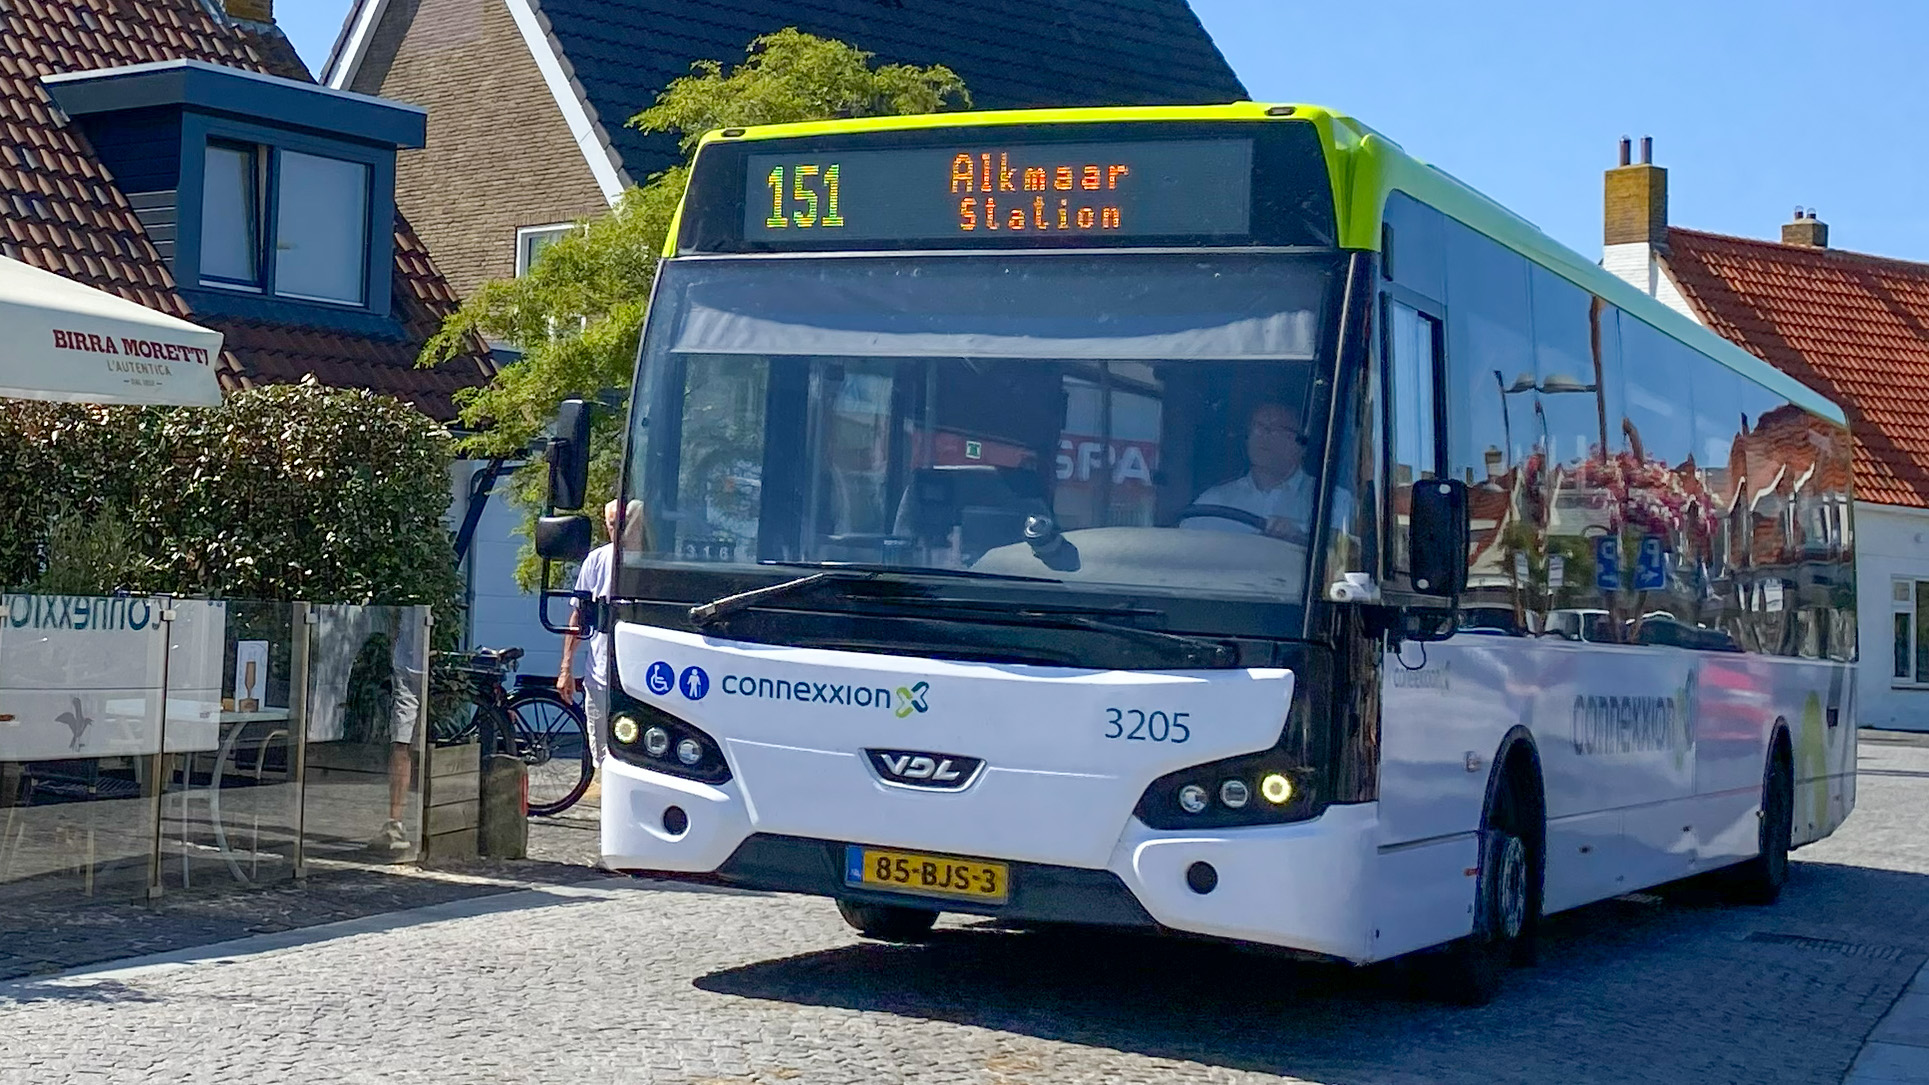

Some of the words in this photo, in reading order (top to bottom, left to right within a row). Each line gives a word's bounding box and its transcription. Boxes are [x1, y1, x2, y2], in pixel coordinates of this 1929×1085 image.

[951, 152, 1129, 194] Alkmaar
[766, 163, 845, 229] 151
[958, 195, 1123, 231] Station
[53, 329, 119, 355] BIRRA
[107, 359, 172, 376] L'AUTENTICA
[722, 674, 891, 709] connexxion
[1105, 707, 1190, 744] 3205
[880, 753, 961, 781] VDL
[876, 857, 996, 894] 85-BJS-3
